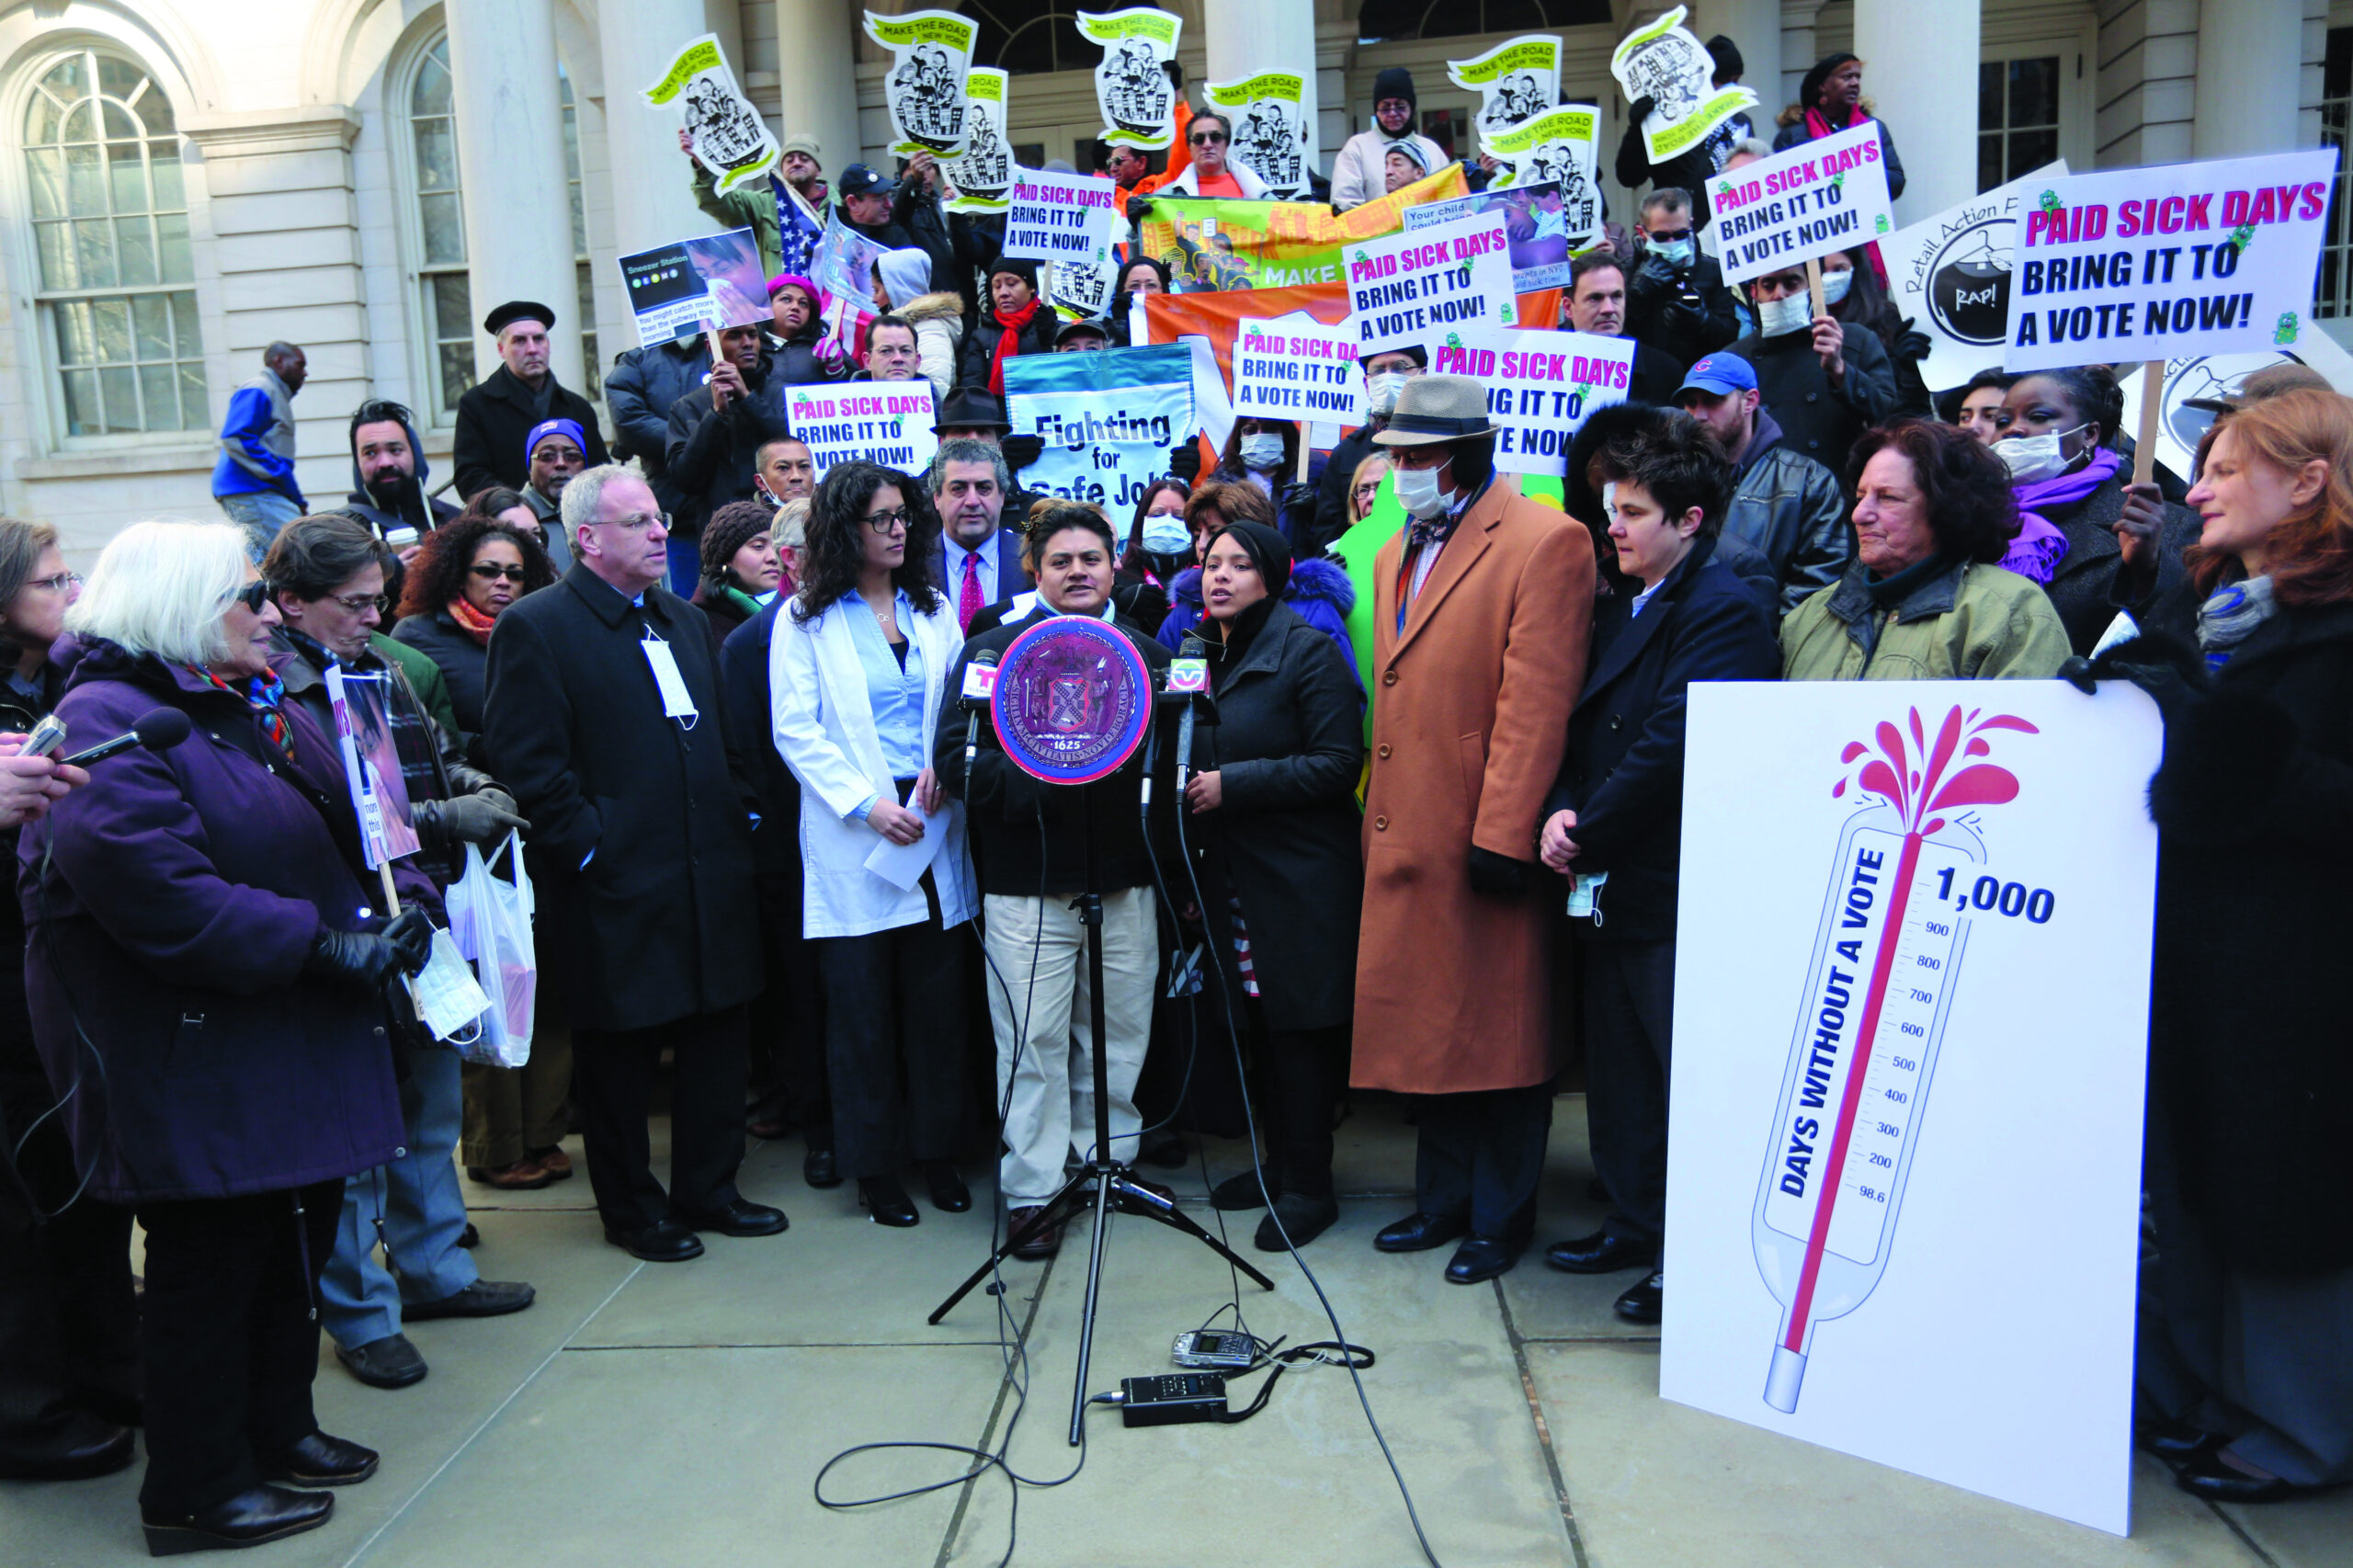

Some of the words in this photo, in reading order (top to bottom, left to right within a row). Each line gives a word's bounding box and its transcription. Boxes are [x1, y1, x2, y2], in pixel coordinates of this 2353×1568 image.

[884, 25, 915, 36] MAKE
[915, 20, 936, 30] THE
[938, 21, 970, 38] ROAD
[1095, 22, 1122, 31] MAKE
[1122, 17, 1142, 26] THE
[1145, 17, 1173, 32] ROAD
[922, 30, 943, 40] NEW
[944, 33, 966, 46] YORK
[656, 76, 676, 98] MAKE
[675, 57, 689, 75] THE
[688, 45, 715, 61] ROAD
[1468, 62, 1498, 77] MAKE
[1498, 49, 1520, 62] THE
[1521, 46, 1553, 56] ROAD
[1506, 57, 1527, 70] NEW
[1529, 57, 1551, 65] YORK
[972, 78, 1000, 88] ROAD
[1221, 86, 1248, 98] MAKE
[1248, 78, 1268, 90] THE
[1271, 77, 1300, 89] ROAD
[1256, 87, 1276, 97] NEW
[1277, 88, 1298, 97] YORK
[1500, 131, 1531, 147] MAKE
[1531, 119, 1555, 132] THE
[1557, 116, 1591, 127] ROAD
[1541, 127, 1563, 139] NEW
[1564, 127, 1588, 136] YORK
[1654, 136, 1686, 153] ROAD
[1714, 180, 1762, 215] PAID
[1765, 160, 1819, 196] SICK
[1821, 140, 1880, 177] DAYS
[1013, 183, 1039, 201] PAID
[1040, 185, 1075, 205] SICK
[1077, 189, 1112, 209] DAYS
[1011, 206, 1047, 225] BRING
[1050, 209, 1064, 226] IT
[1067, 210, 1085, 228] TO
[1410, 211, 1434, 221] Your
[1438, 203, 1465, 214] child
[1720, 201, 1784, 242] BRING
[1788, 193, 1807, 218] IT
[1812, 183, 1842, 210] TO
[2025, 204, 2109, 247] PAID
[2116, 192, 2213, 238] SICK
[2220, 181, 2326, 229] DAYS
[1008, 230, 1017, 246] A
[1018, 230, 1048, 248] VOTE
[1051, 233, 1090, 252] NOW!
[1725, 248, 1740, 271] A
[1741, 230, 1795, 265] VOTE
[1797, 209, 1859, 246] NOW!
[1905, 238, 1940, 293] Retail
[1941, 206, 1996, 240] Action
[627, 260, 660, 275] Sneezer
[660, 255, 689, 267] Station
[1351, 254, 1396, 284] PAID
[1401, 241, 1450, 275] SICK
[1453, 228, 1506, 259] DAYS
[2021, 251, 2132, 296] BRING
[2143, 246, 2182, 285] IT
[2190, 241, 2240, 280] TO
[1265, 264, 1336, 289] MAKE
[1356, 278, 1417, 312] BRING
[1421, 273, 1440, 297] IT
[1446, 267, 1471, 291] TO
[1955, 283, 1996, 312] RAP!
[638, 315, 653, 325] You
[653, 310, 674, 323] might
[674, 304, 694, 315] catch
[695, 299, 715, 309] more
[641, 324, 657, 334] than
[658, 320, 670, 329] the
[670, 313, 698, 325] subway
[699, 307, 714, 317] this
[1360, 319, 1374, 341] A
[1376, 308, 1426, 337] VOTE
[1429, 294, 1486, 324] NOW!
[2016, 312, 2038, 347] A
[2047, 302, 2135, 344] VOTE
[2143, 292, 2254, 335] NOW!
[643, 329, 673, 342] morning
[1244, 334, 1285, 355] PAID
[1290, 337, 1333, 359] SICK
[1337, 342, 1359, 362] DA
[1243, 358, 1299, 381] BRING
[1303, 363, 1321, 383] IT
[1324, 365, 1347, 385] TO
[1435, 346, 1495, 377] PAID
[1501, 351, 1566, 382] SICK
[1570, 356, 1629, 390] DAYS
[1695, 359, 1712, 372] C
[793, 400, 835, 421] PAID
[839, 396, 884, 417] SICK
[887, 395, 932, 415] DAYS
[1240, 384, 1252, 403] A
[1256, 386, 1301, 408] VOTE
[1306, 390, 1355, 413] NOW!
[1519, 390, 1546, 416] IT
[1552, 392, 1583, 420] TO
[796, 423, 854, 445] BRING
[858, 422, 874, 440] IT
[879, 420, 902, 439] TO
[1035, 410, 1172, 451] Fighting
[1520, 427, 1575, 458] NOW
[815, 449, 860, 471] VOTE
[864, 446, 915, 466] NOW!
[1092, 446, 1121, 471] for
[1054, 740, 1081, 750] 1625
[1841, 847, 1884, 928] VOTE
[1937, 867, 2055, 925] 1,000
[1926, 921, 1949, 937] 900
[1836, 940, 1863, 964] A
[1916, 955, 1940, 971] 800
[1910, 988, 1932, 1004] 700
[1799, 965, 1855, 1109] WITHOUT
[1901, 1022, 1924, 1038] 600
[1893, 1056, 1915, 1072] 500
[1884, 1088, 1907, 1104] 400
[1876, 1121, 1899, 1137] 300
[1779, 1116, 1819, 1199] DAYS
[1869, 1153, 1892, 1169] 200
[1859, 1185, 1885, 1203] 98.6
